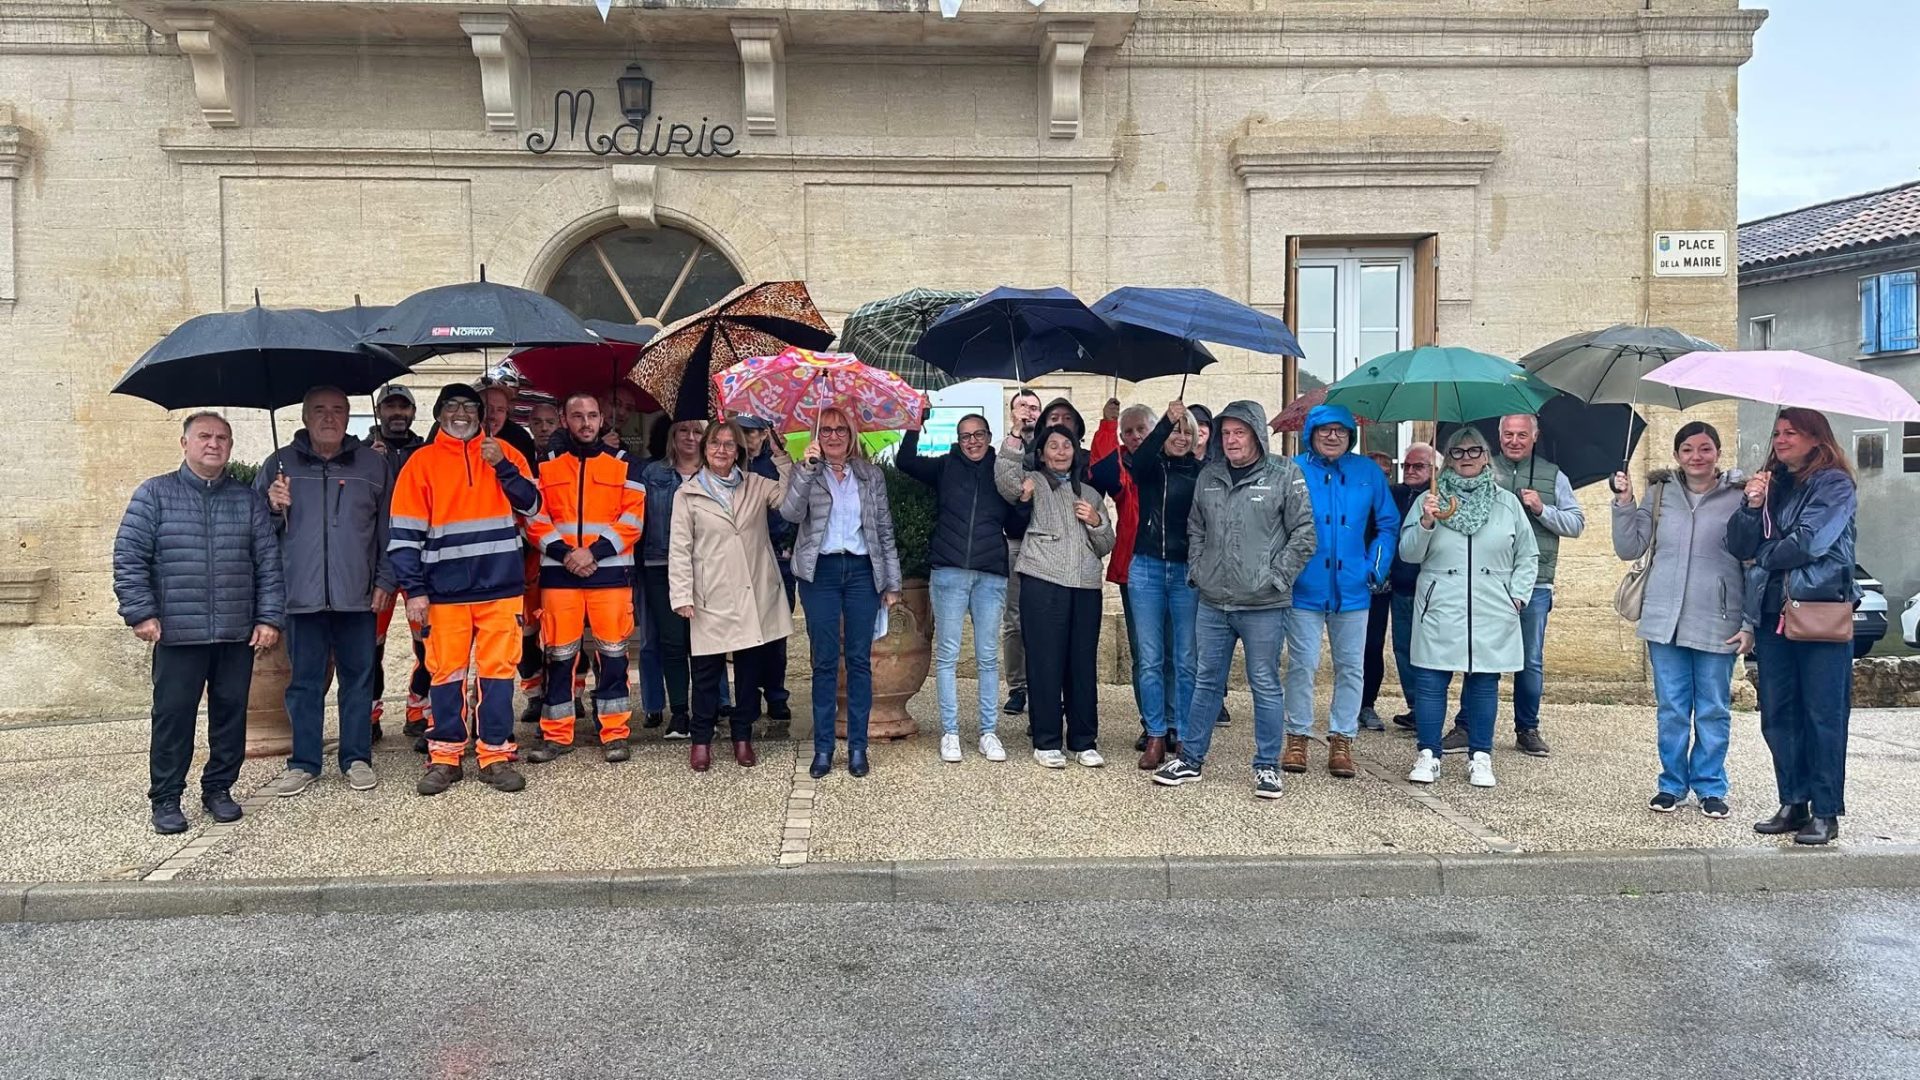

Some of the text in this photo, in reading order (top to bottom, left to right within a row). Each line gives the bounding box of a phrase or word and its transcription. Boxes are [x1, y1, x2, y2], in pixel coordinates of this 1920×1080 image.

[526, 89, 741, 157] Mairie
[1679, 240, 1715, 250] PLACE
[1684, 257, 1722, 267] MAIRIE
[450, 326, 495, 336] NORWAY
